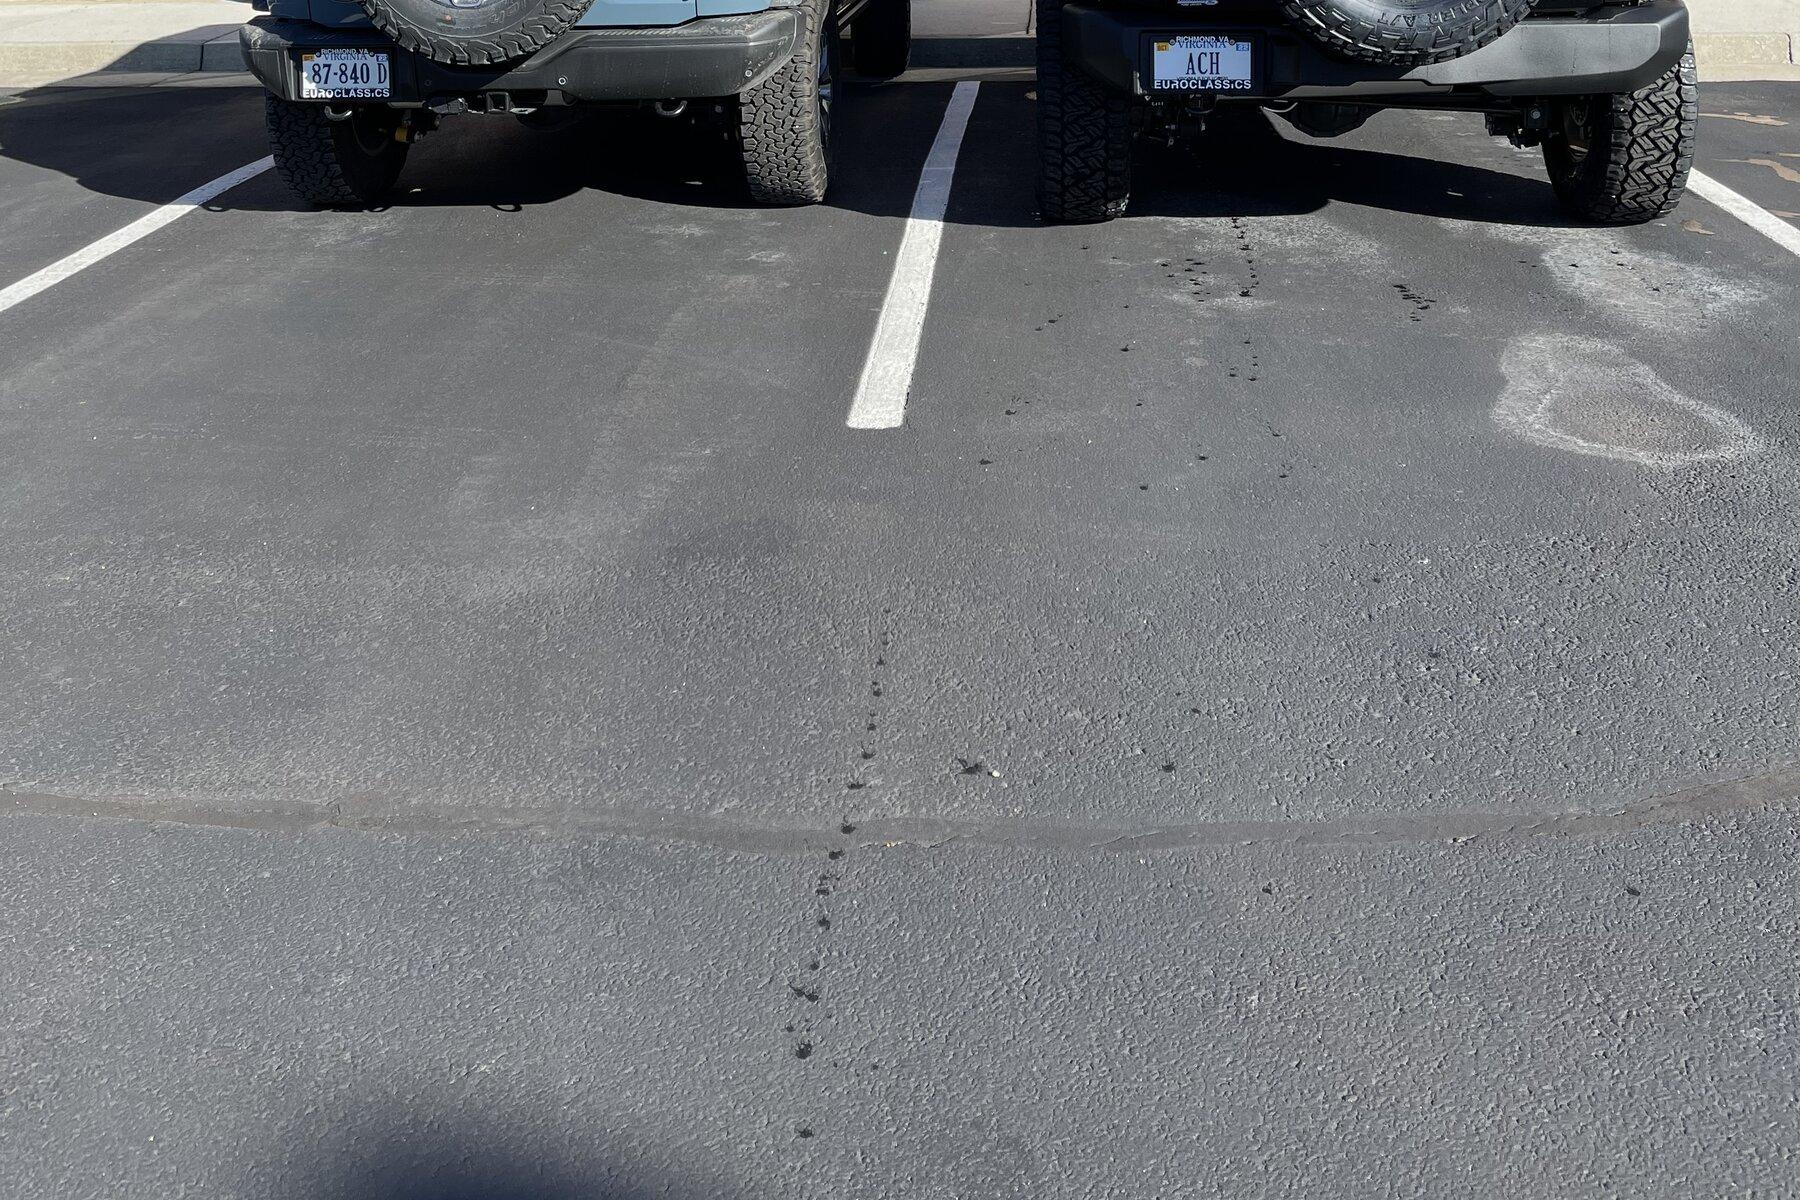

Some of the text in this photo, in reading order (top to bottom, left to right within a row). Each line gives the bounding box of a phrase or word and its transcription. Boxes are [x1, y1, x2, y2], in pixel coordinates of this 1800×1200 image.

[312, 63, 387, 84] 87-840 D
[1186, 52, 1220, 74] ACH
